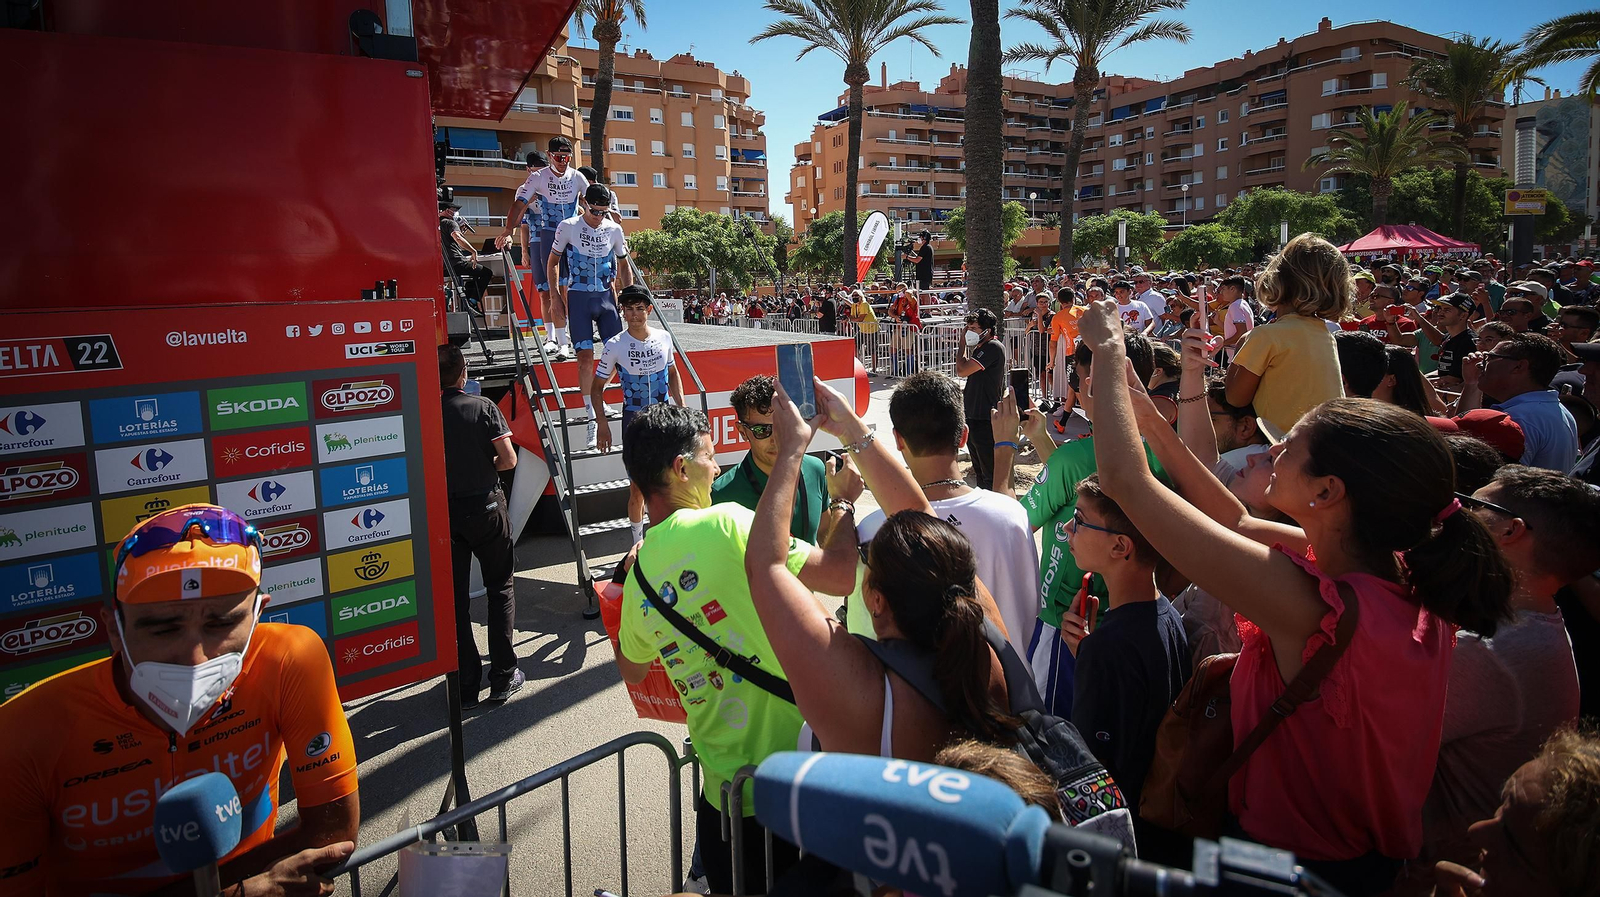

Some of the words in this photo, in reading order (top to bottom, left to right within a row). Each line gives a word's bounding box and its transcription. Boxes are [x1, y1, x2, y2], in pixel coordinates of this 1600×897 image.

[579, 233, 602, 243] ISRAEL
[165, 329, 248, 348] @lavuelta
[77, 341, 109, 365] 22
[349, 346, 373, 356] UCI
[628, 349, 655, 359] ISRAEL
[216, 396, 300, 416] ŠKODA
[119, 419, 178, 433] LOTERÍAS
[0, 438, 55, 451] arrefour
[354, 433, 399, 446] plenitude
[245, 441, 306, 458] Cofidis
[127, 473, 181, 487] Carrefour
[342, 483, 389, 496] LOTERÍAS
[244, 503, 292, 517] Carrefour
[25, 524, 87, 541] plenitude
[348, 529, 390, 542] Carrefour
[1040, 544, 1064, 609] ŠKODA
[11, 583, 75, 602] LOTERÍAS
[267, 577, 316, 594] plenitude
[339, 595, 410, 621] ŠKODA
[363, 635, 414, 655] Cofidis
[630, 691, 664, 706] TIENDA
[116, 732, 133, 740] UCI
[203, 718, 261, 746] urbycolan
[121, 741, 143, 750] TEAM
[296, 752, 340, 773] MENABI
[62, 731, 271, 828] euskltel
[63, 758, 153, 789] ORBEA
[881, 759, 971, 804] tve
[215, 795, 243, 823] tve
[159, 820, 200, 845] tve
[863, 813, 958, 897] tve
